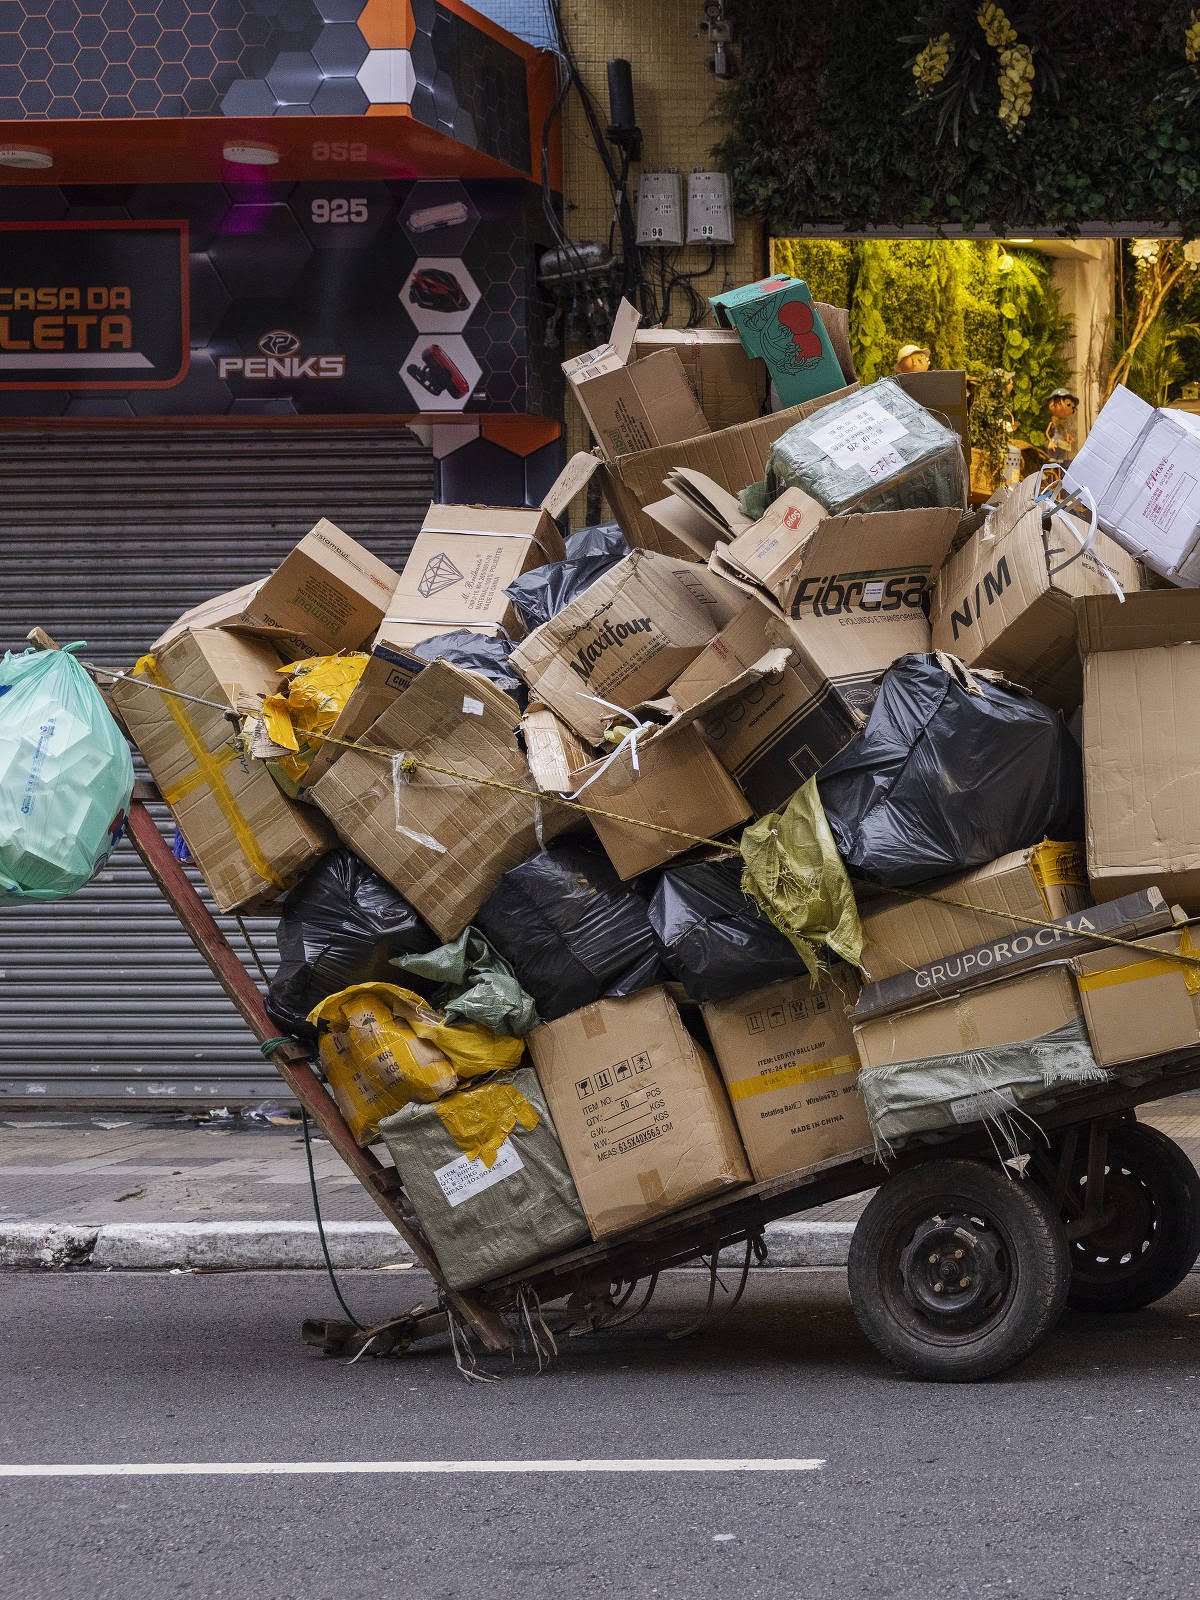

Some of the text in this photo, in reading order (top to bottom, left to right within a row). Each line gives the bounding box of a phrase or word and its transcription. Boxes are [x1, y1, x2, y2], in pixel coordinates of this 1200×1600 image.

[312, 199, 368, 223] 925
[652, 228, 663, 237] 98
[702, 226, 713, 235] 99
[88, 287, 131, 310] DA
[219, 357, 344, 378] PENKS
[786, 510, 801, 527] Soya
[951, 555, 1011, 641] N/M
[570, 617, 653, 686] Maxifour
[915, 916, 1096, 988] GRUPOROCHA
[377, 1050, 393, 1062] KGS
[774, 1053, 785, 1062] LED
[797, 1046, 811, 1055] BALL
[811, 1041, 826, 1051] LAMP
[783, 1061, 797, 1069] PCS
[582, 1096, 614, 1115] ITEM NO.
[620, 1099, 630, 1110] 50
[645, 1087, 662, 1100] PCS
[649, 1099, 666, 1111] KGS
[760, 1108, 785, 1118] Rotating
[806, 1093, 832, 1105] Wireless
[653, 1110, 670, 1123] KGS
[790, 1114, 845, 1135] MADE IN CHINA
[661, 1122, 674, 1133] CM
